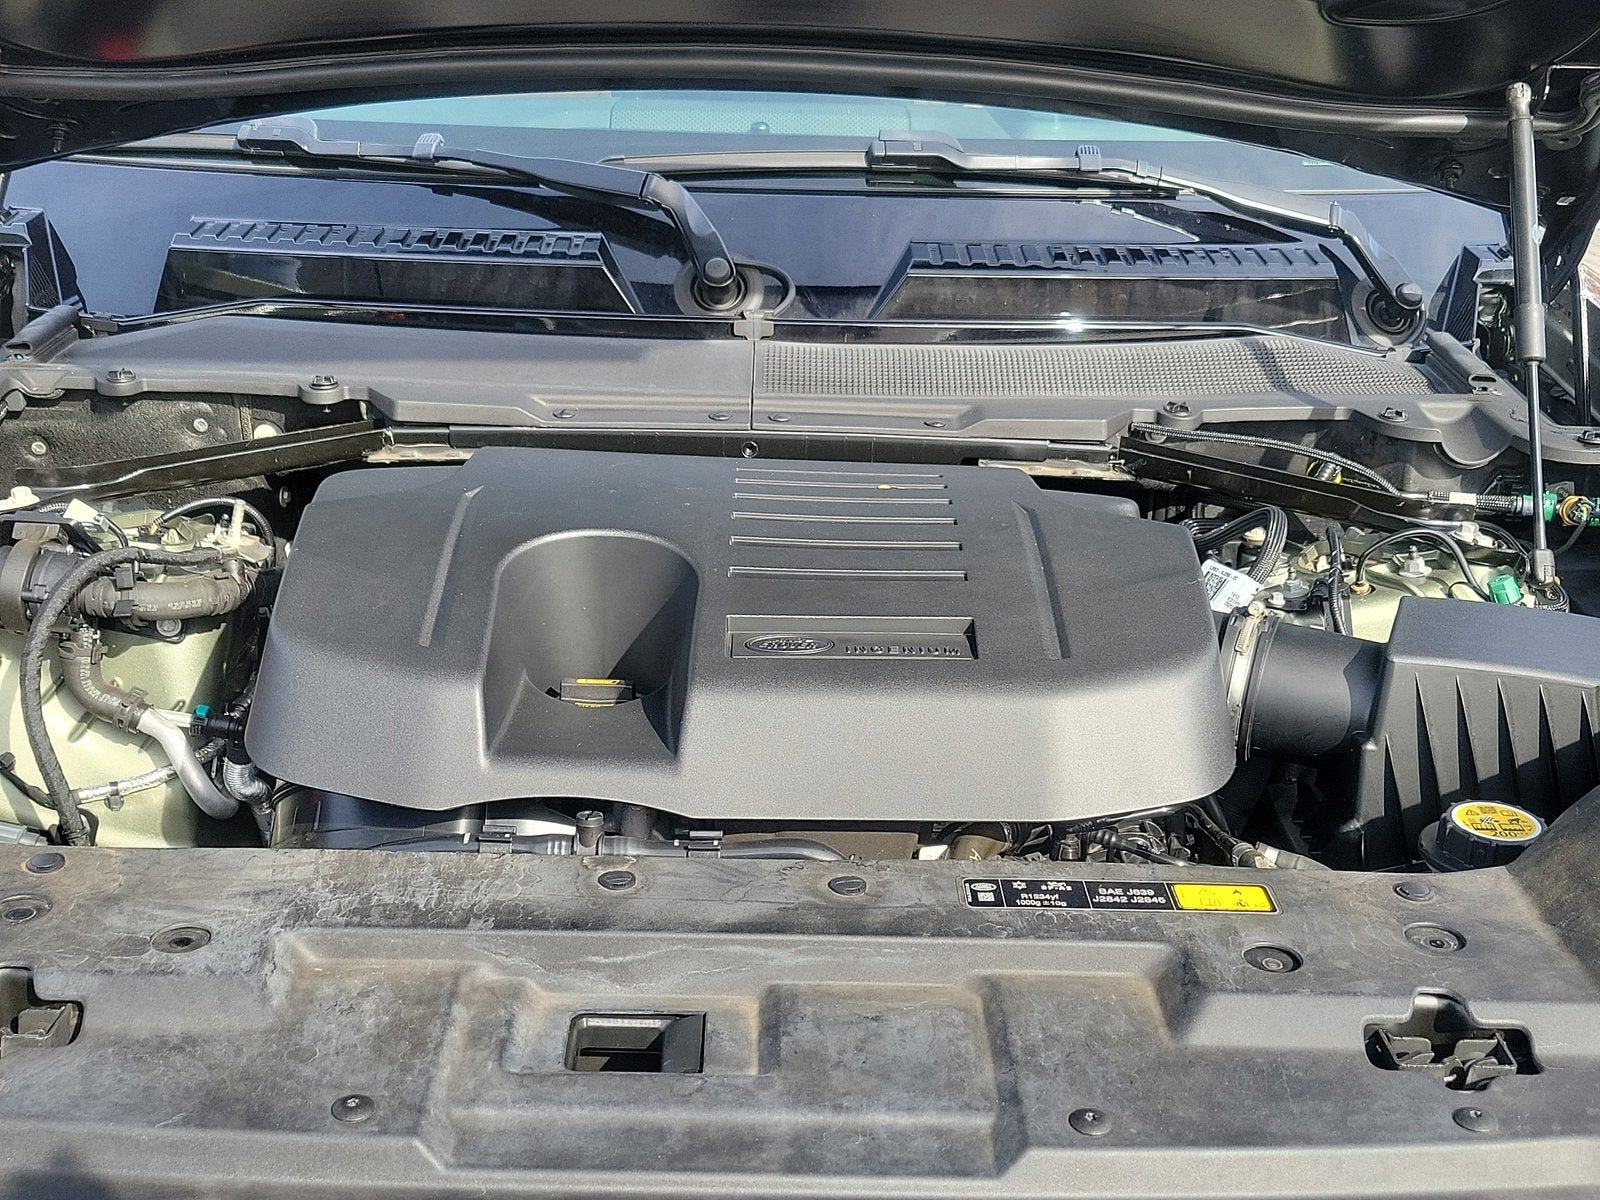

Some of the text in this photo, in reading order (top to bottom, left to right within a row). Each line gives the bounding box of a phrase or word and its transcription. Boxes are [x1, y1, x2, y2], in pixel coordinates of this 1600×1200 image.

[845, 645, 961, 656] INGENIUM
[1098, 887, 1155, 896] SAE J639
[1020, 893, 1059, 901] R1234yf
[1092, 895, 1166, 904] J2842 J2845
[1016, 899, 1041, 907] 1000g
